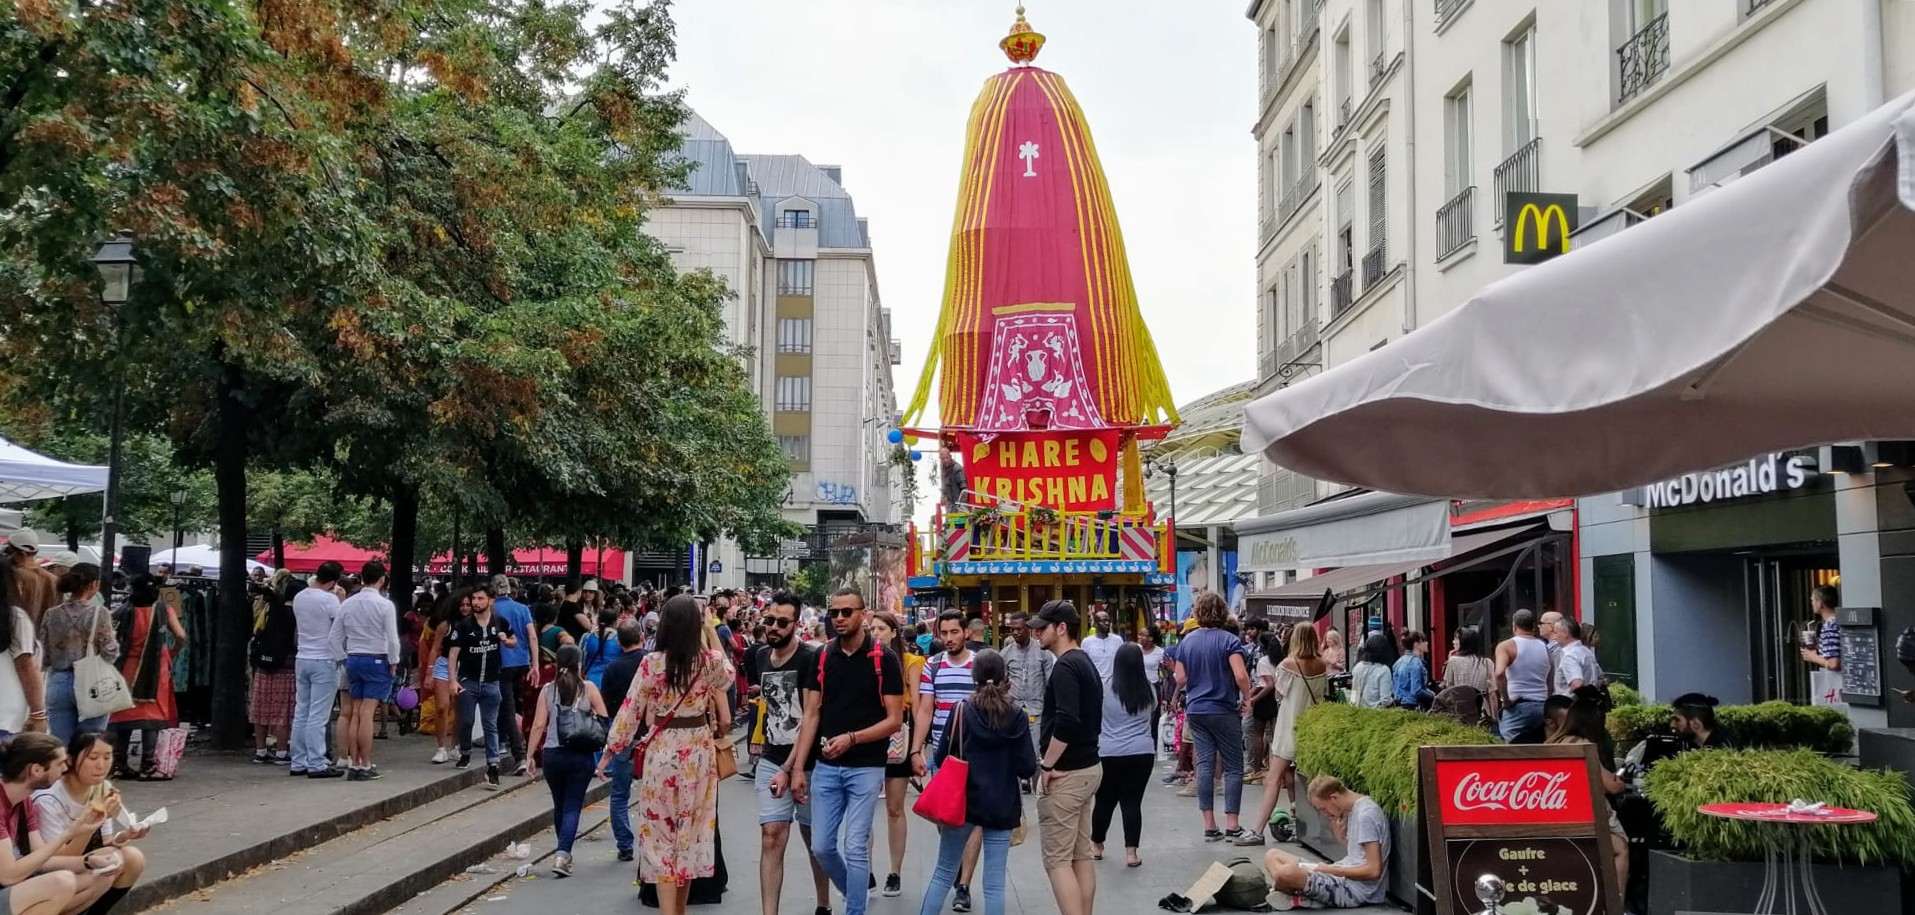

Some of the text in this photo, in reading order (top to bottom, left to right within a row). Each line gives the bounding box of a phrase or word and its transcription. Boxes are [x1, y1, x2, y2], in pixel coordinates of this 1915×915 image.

[999, 439, 1080, 468] HARE
[973, 474, 1109, 506] KRISHNA
[1645, 452, 1805, 508] McDonald's
[1251, 536, 1298, 566] McDonald's
[469, 643, 498, 653] Emirates
[1453, 771, 1572, 811] Coca-Cola
[1499, 847, 1546, 860] Gaufre
[1517, 879, 1537, 892] de
[1539, 879, 1578, 894] glace
